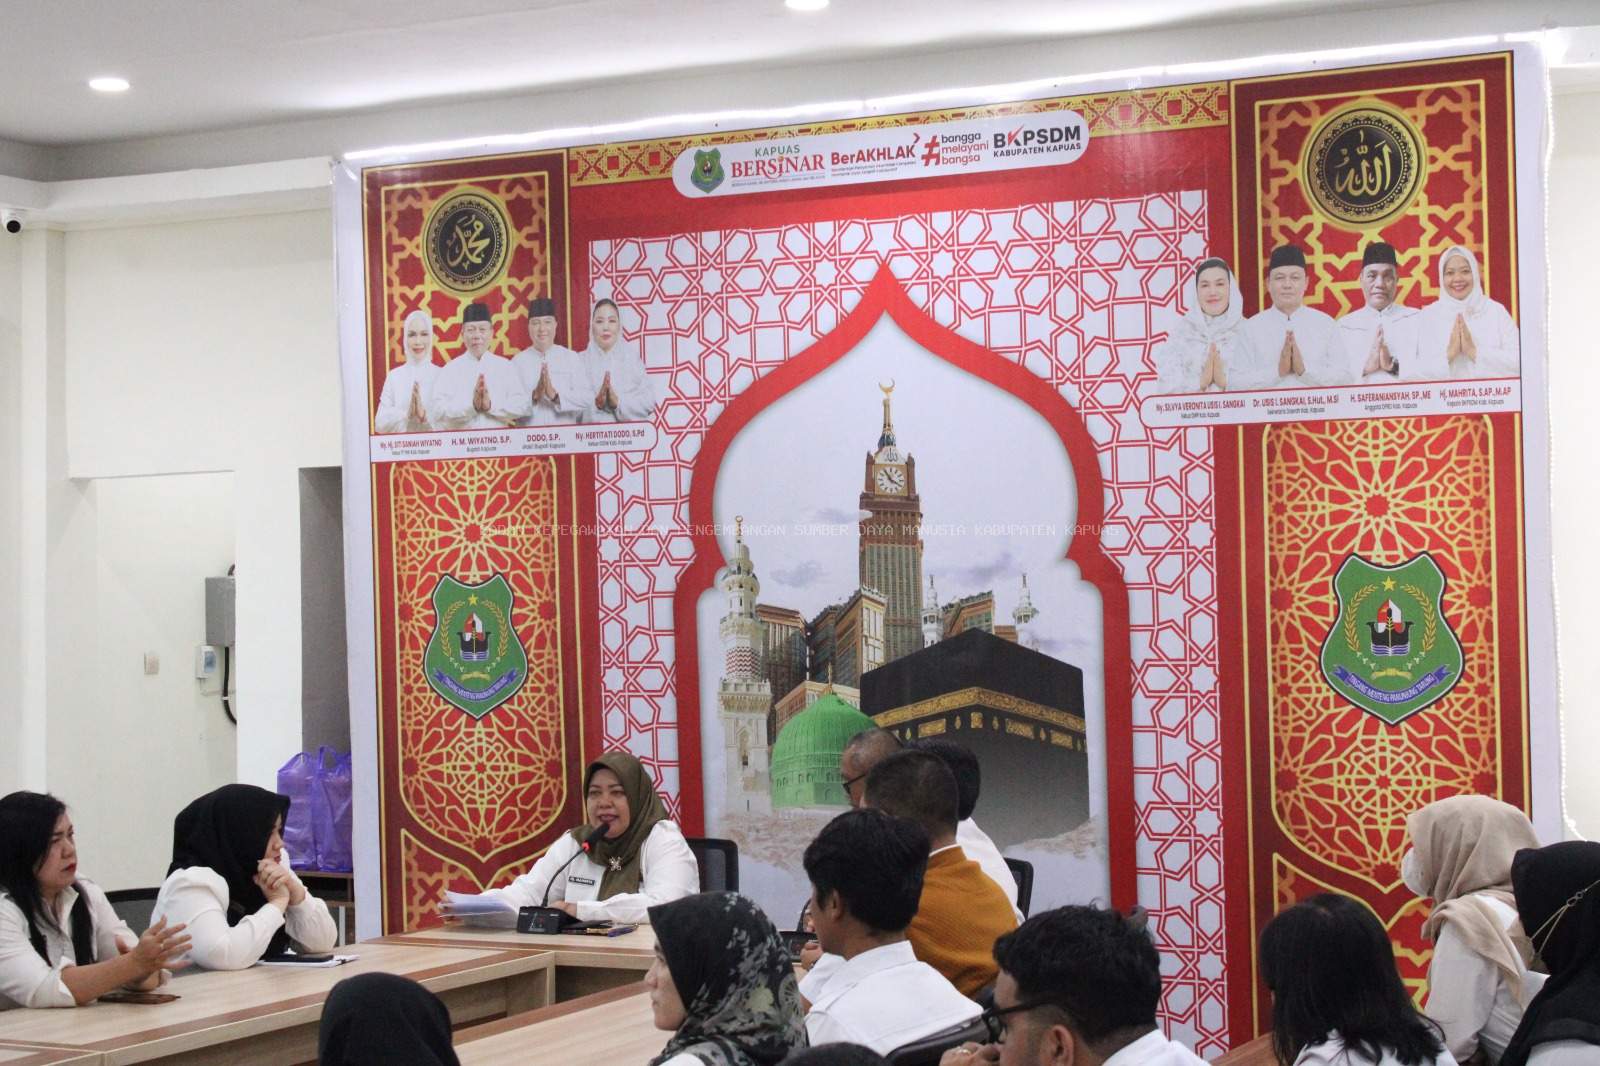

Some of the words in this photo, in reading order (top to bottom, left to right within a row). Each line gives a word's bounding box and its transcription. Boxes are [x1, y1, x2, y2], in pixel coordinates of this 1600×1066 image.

[941, 132, 982, 145] bangga
[993, 124, 1081, 149] BKPSDM
[755, 144, 800, 157] KAPUAS
[941, 140, 989, 154] melayani
[993, 147, 1045, 158] KABUPATEN
[1046, 142, 1082, 153] KAPUAS
[831, 144, 916, 166] BerAKHLAK
[941, 153, 981, 166] bangsa
[451, 438, 458, 446] H.
